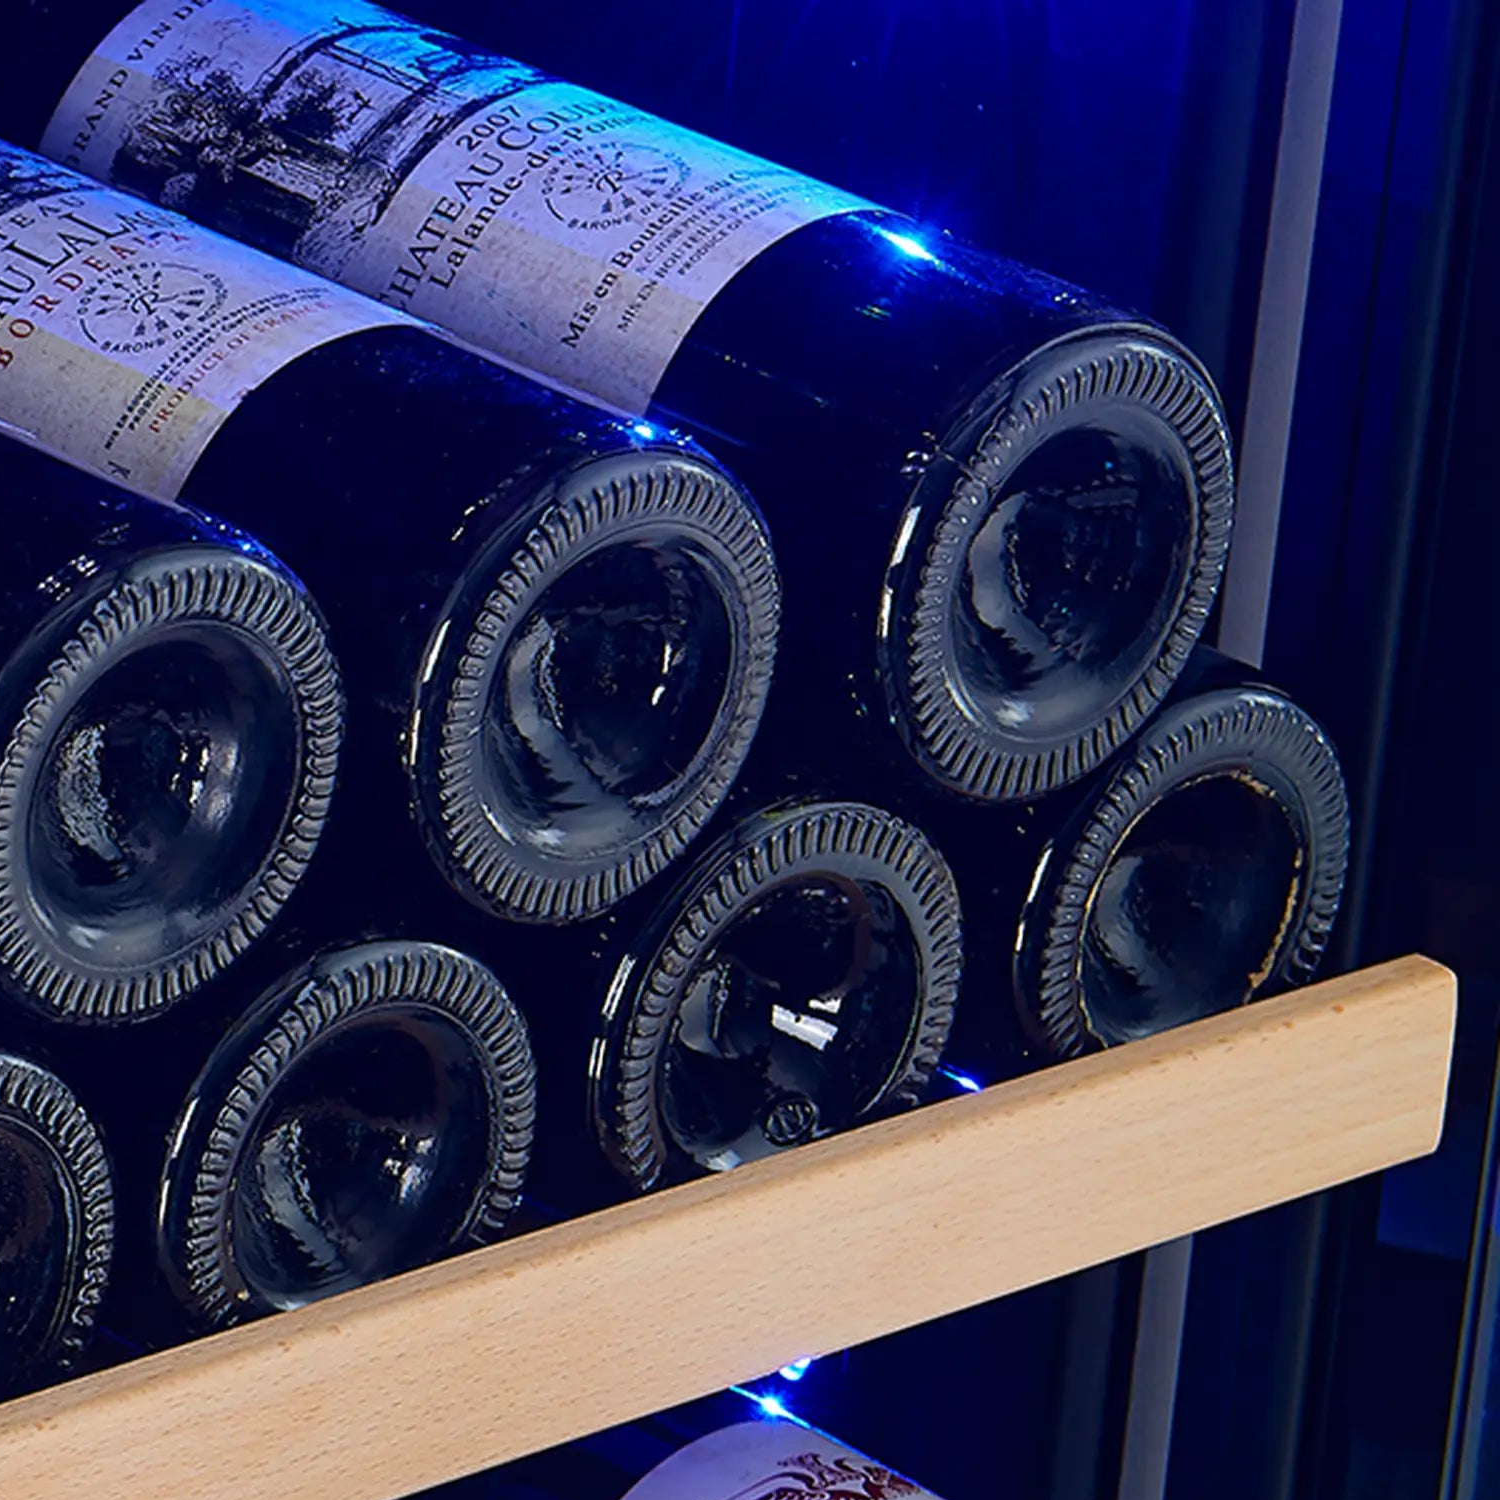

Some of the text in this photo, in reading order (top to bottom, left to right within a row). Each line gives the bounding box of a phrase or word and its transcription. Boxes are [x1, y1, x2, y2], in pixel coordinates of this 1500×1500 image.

[127, 21, 172, 61] VIN
[456, 103, 521, 152] 2007
[560, 191, 705, 349] Mis en Bouteille
[148, 350, 227, 433] PRODUCE
[227, 331, 252, 352] OF
